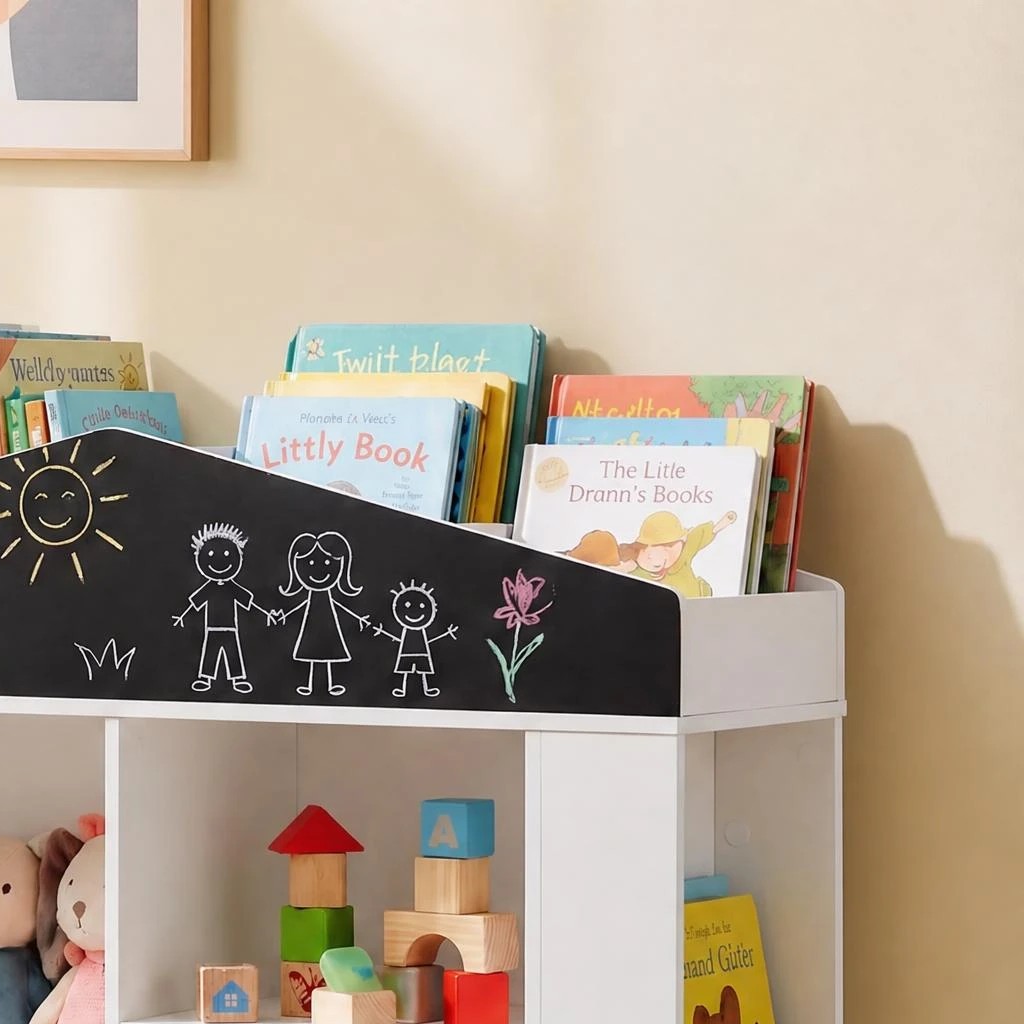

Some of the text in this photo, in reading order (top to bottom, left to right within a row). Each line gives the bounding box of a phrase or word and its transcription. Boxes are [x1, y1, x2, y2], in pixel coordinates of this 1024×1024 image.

[261, 430, 430, 472] Littly Book
[599, 460, 637, 479] The
[568, 484, 714, 504] Drann's Books
[428, 814, 459, 849] A
